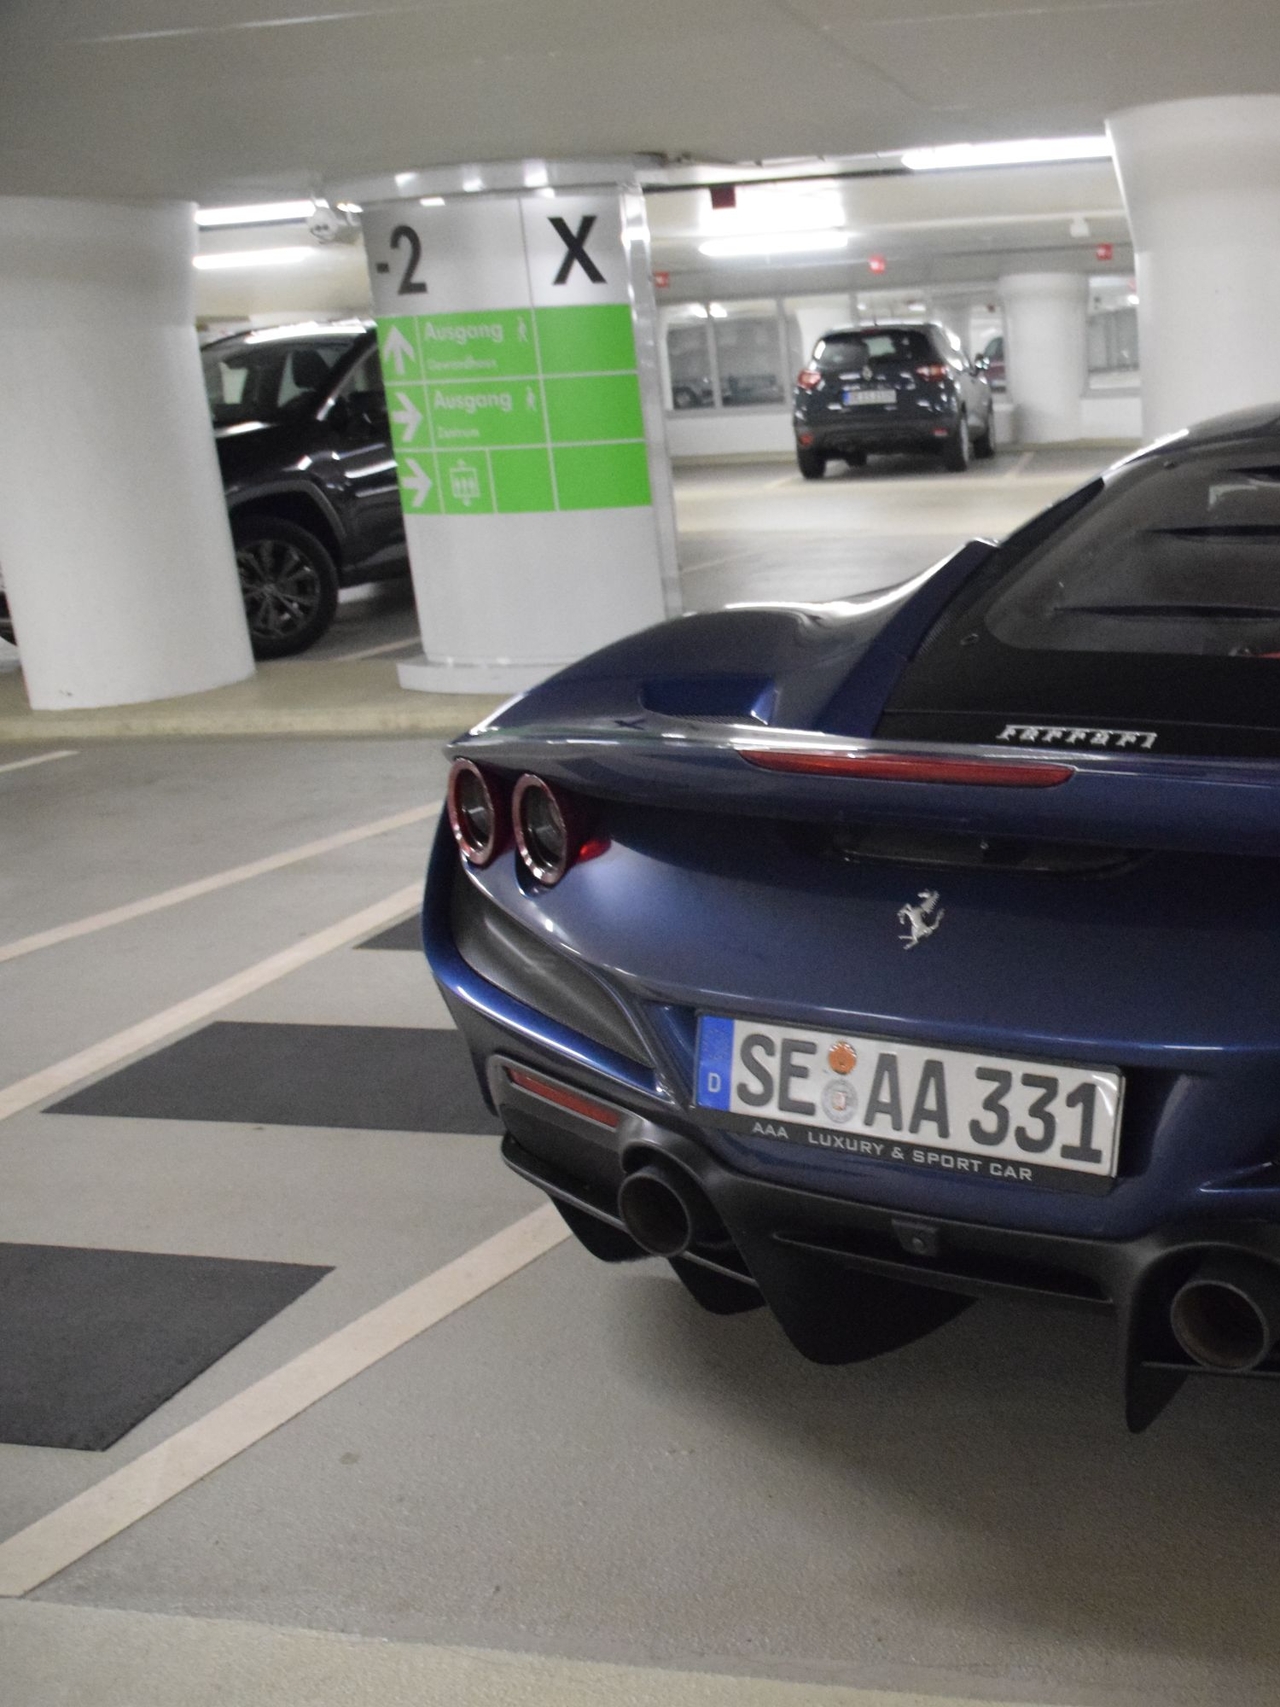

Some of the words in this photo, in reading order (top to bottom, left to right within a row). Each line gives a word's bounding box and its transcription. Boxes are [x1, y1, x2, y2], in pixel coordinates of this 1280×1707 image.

[547, 215, 607, 285] X
[424, 322, 503, 345] Ausgang
[434, 389, 513, 414] Ausgang
[707, 1071, 721, 1093] D
[736, 1033, 818, 1116] SE
[864, 1053, 950, 1139] AA
[969, 1066, 1103, 1164] 331
[752, 1122, 789, 1139] AAA
[808, 1131, 885, 1155] LUXURY
[891, 1146, 905, 1160] &
[912, 1149, 982, 1173] SPORT
[989, 1163, 1033, 1181] CAR
